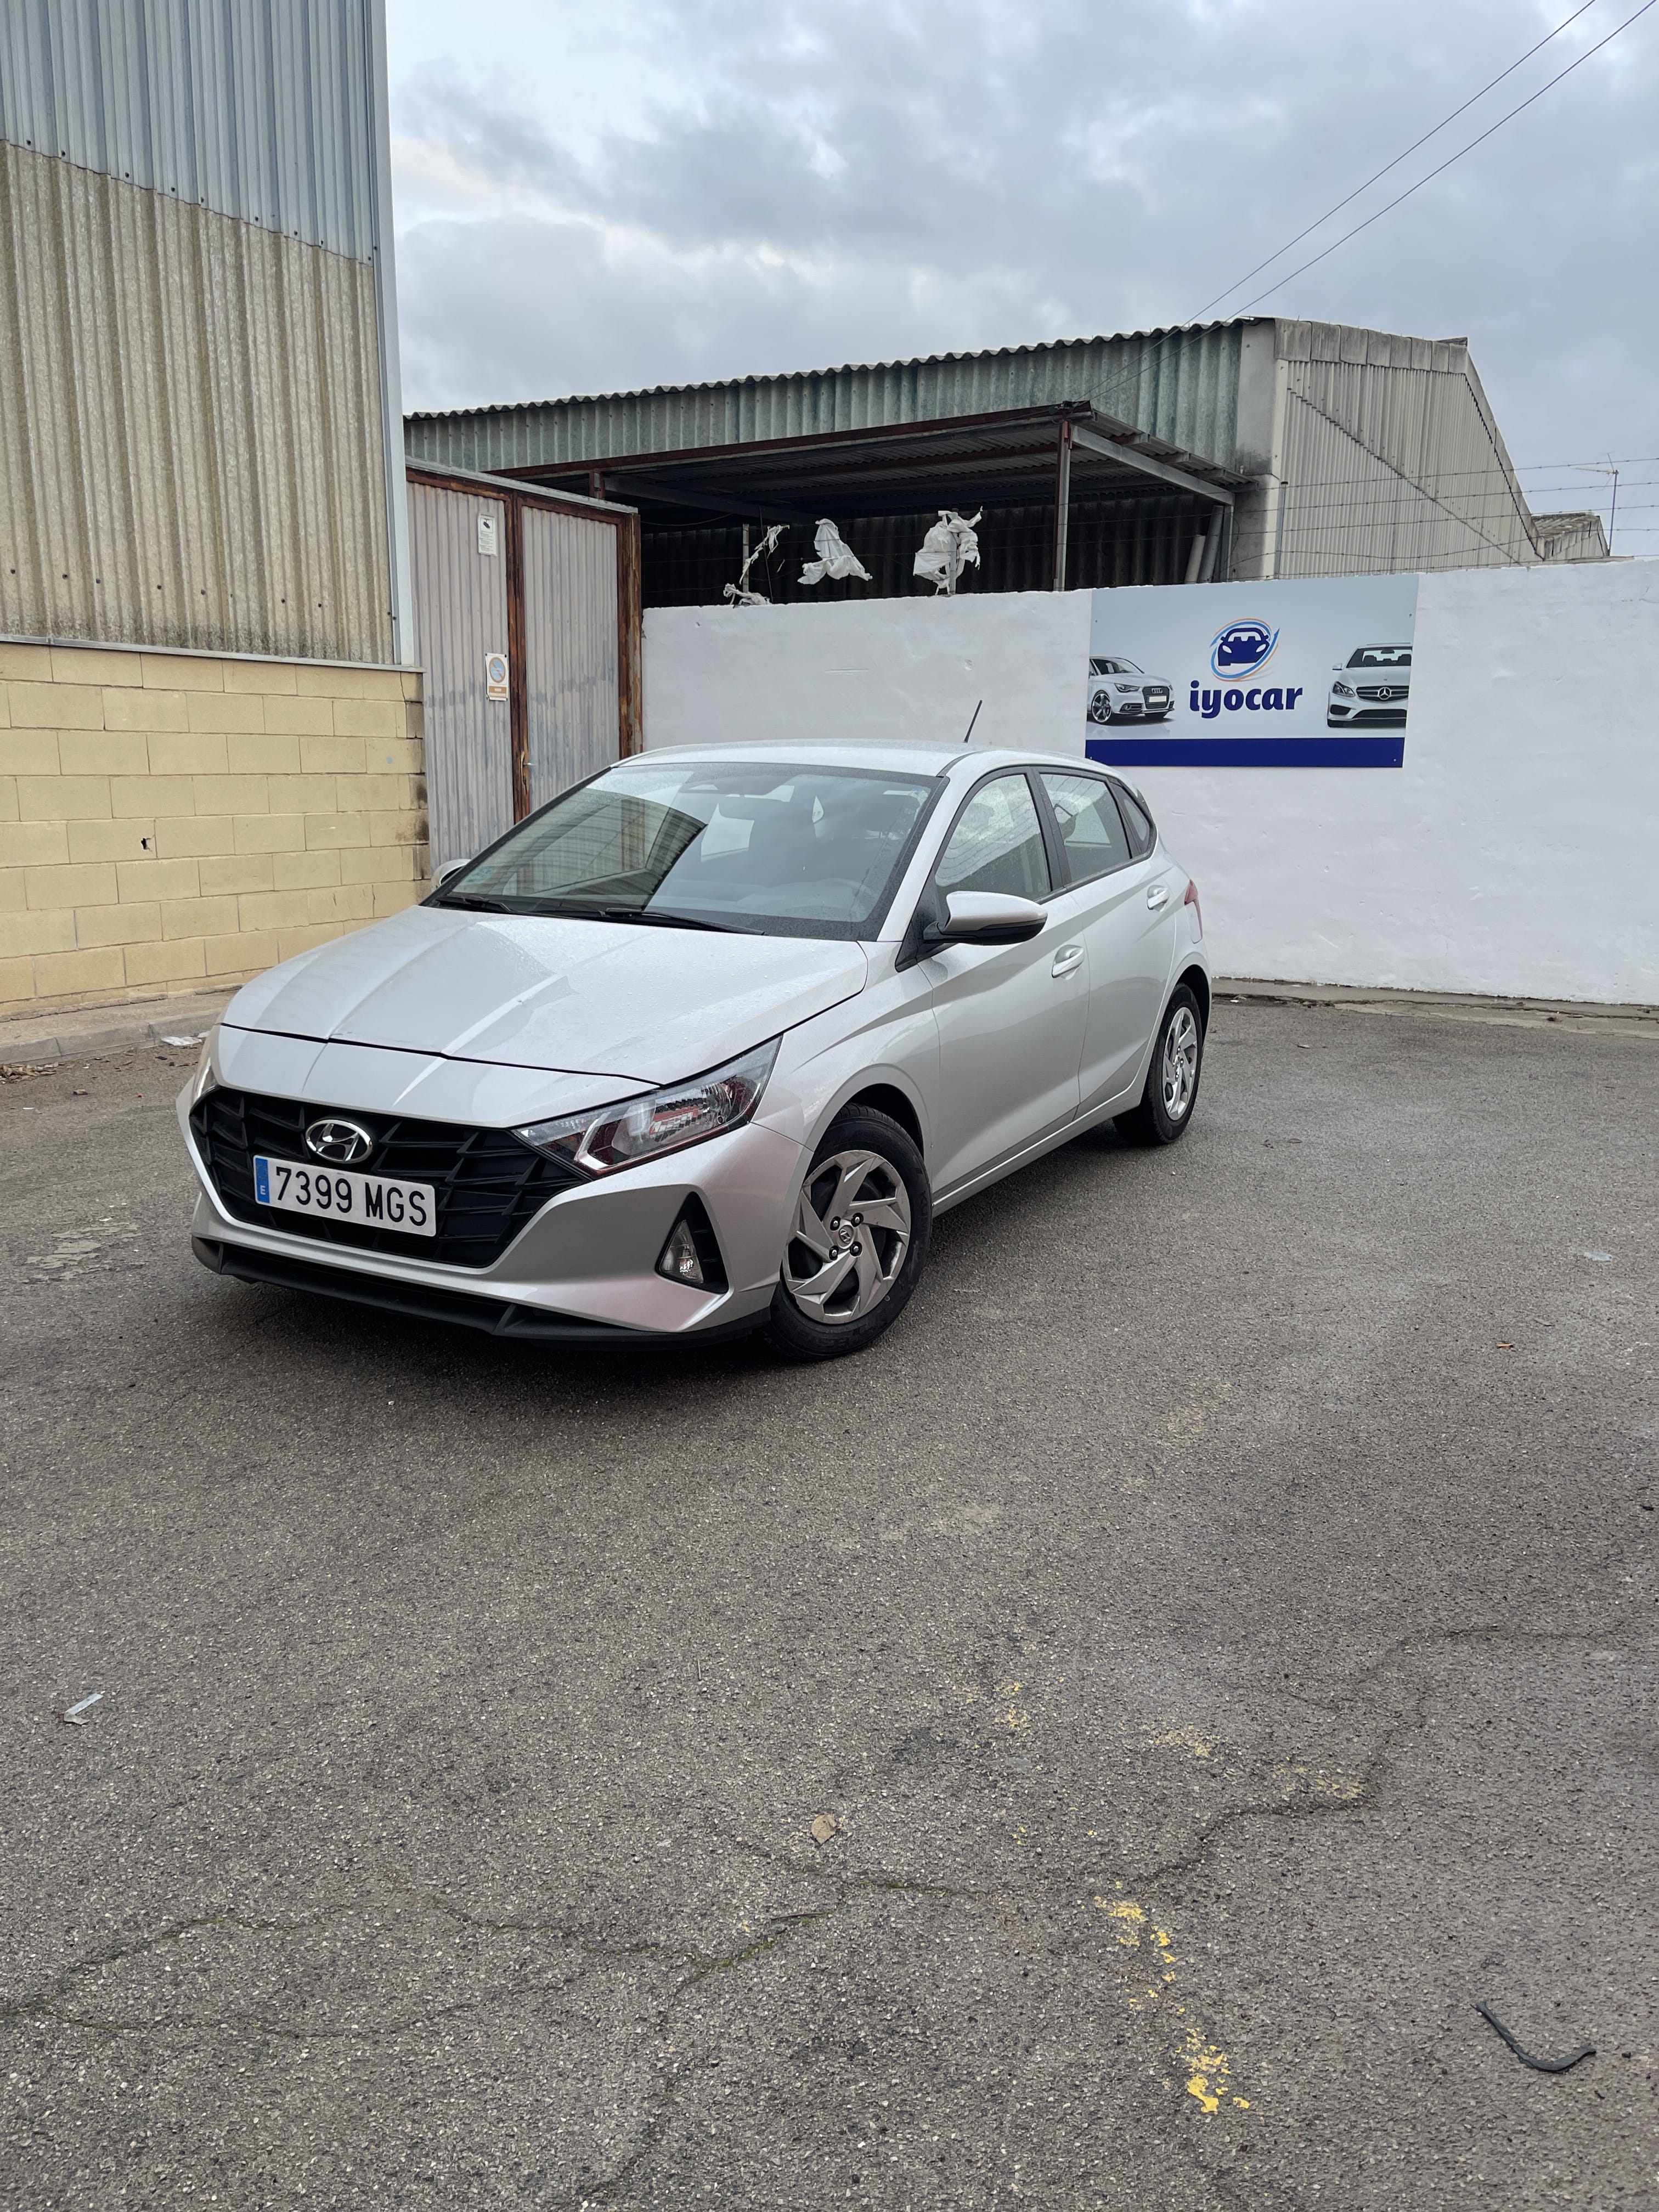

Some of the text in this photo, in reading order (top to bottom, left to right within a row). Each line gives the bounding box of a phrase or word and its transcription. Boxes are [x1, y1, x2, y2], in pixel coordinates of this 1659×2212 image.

[1189, 680, 1303, 719] iyocar
[259, 1167, 427, 1226] E 7399 MGS
